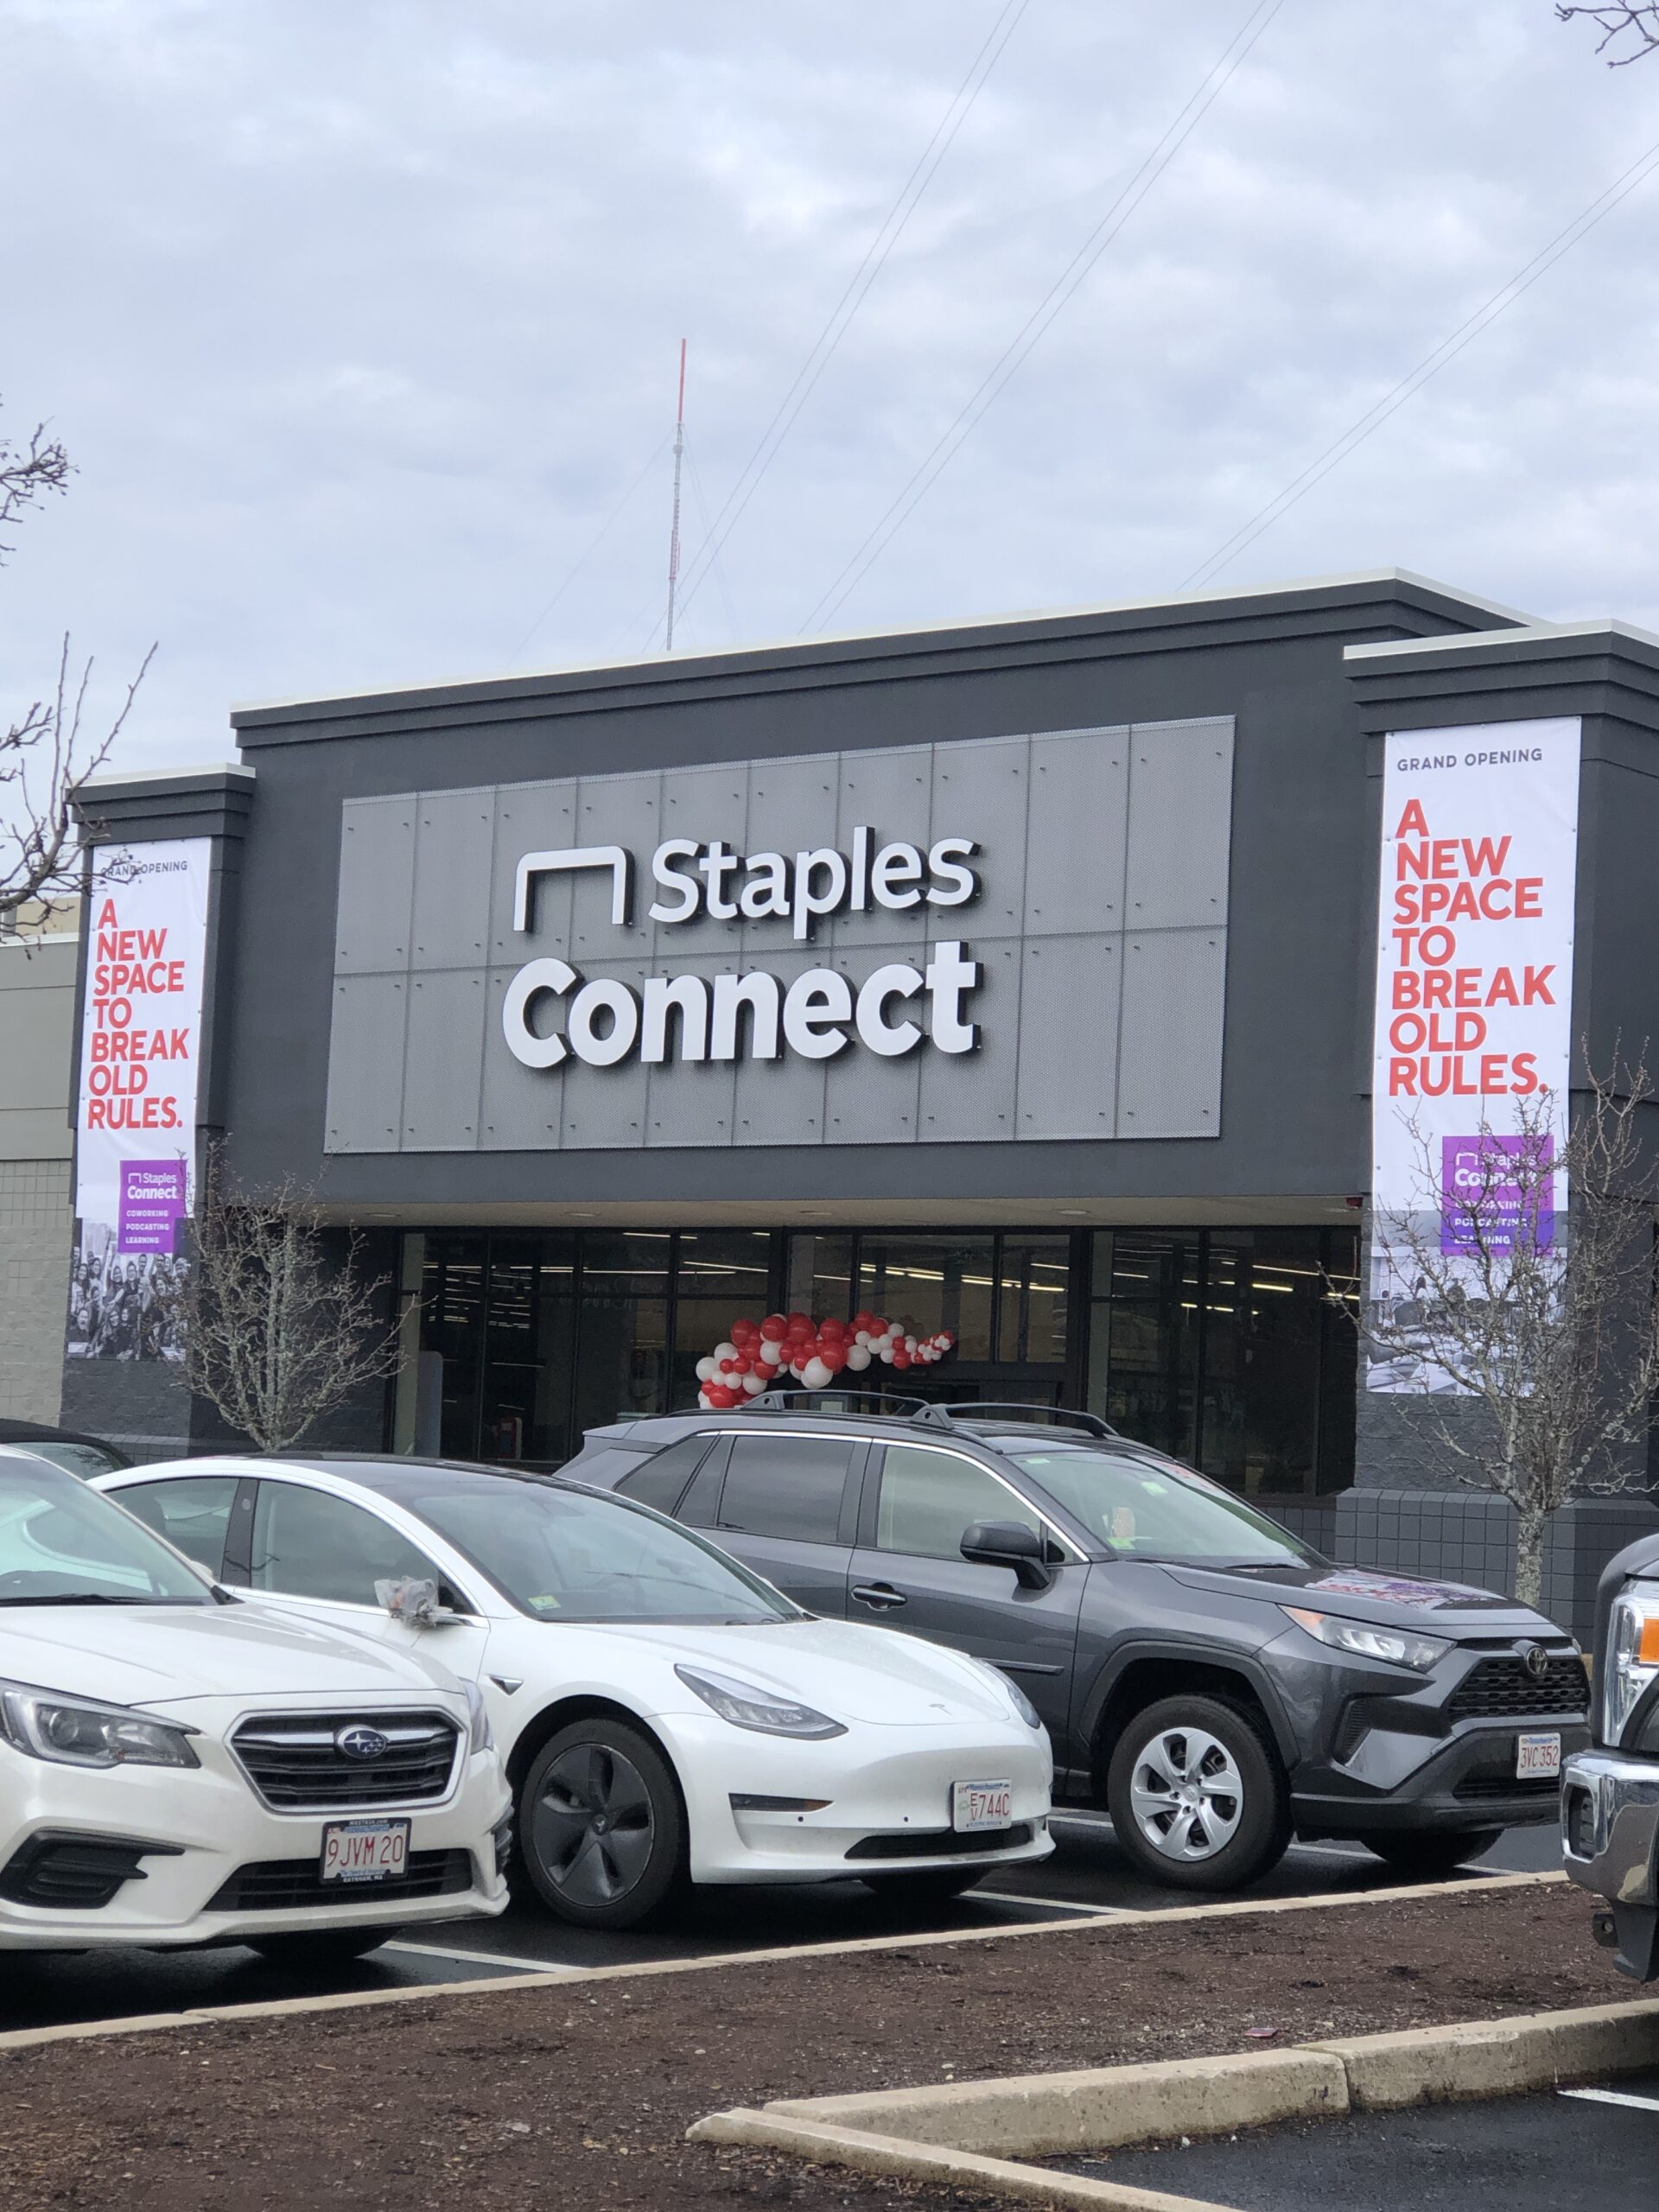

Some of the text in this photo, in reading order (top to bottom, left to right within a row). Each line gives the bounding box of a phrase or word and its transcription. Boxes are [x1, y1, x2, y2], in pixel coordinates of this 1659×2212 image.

[1396, 748, 1543, 772] GRAND OPENING
[1395, 798, 1430, 839] A
[140, 861, 188, 874] OPENING
[1396, 835, 1512, 881] NEW
[648, 825, 982, 940] Staples
[97, 898, 118, 929] A
[1392, 876, 1544, 925] SPACE
[96, 928, 168, 962] NEW
[1391, 925, 1456, 968] TO
[93, 960, 185, 996] SPACE
[1392, 964, 1557, 1010] BREAK
[92, 996, 132, 1029] TO
[502, 940, 983, 1069] Connect
[91, 1028, 190, 1063] BREAK
[1389, 1011, 1487, 1054] OLD
[88, 1064, 148, 1096] OLD
[1389, 1052, 1548, 1096] RULES.
[87, 1096, 183, 1130] RULES.
[127, 1185, 178, 1199] Connect
[143, 1173, 177, 1186] Staples
[1521, 1745, 1559, 1768] 3VC 352
[379, 1834, 404, 1864] 20
